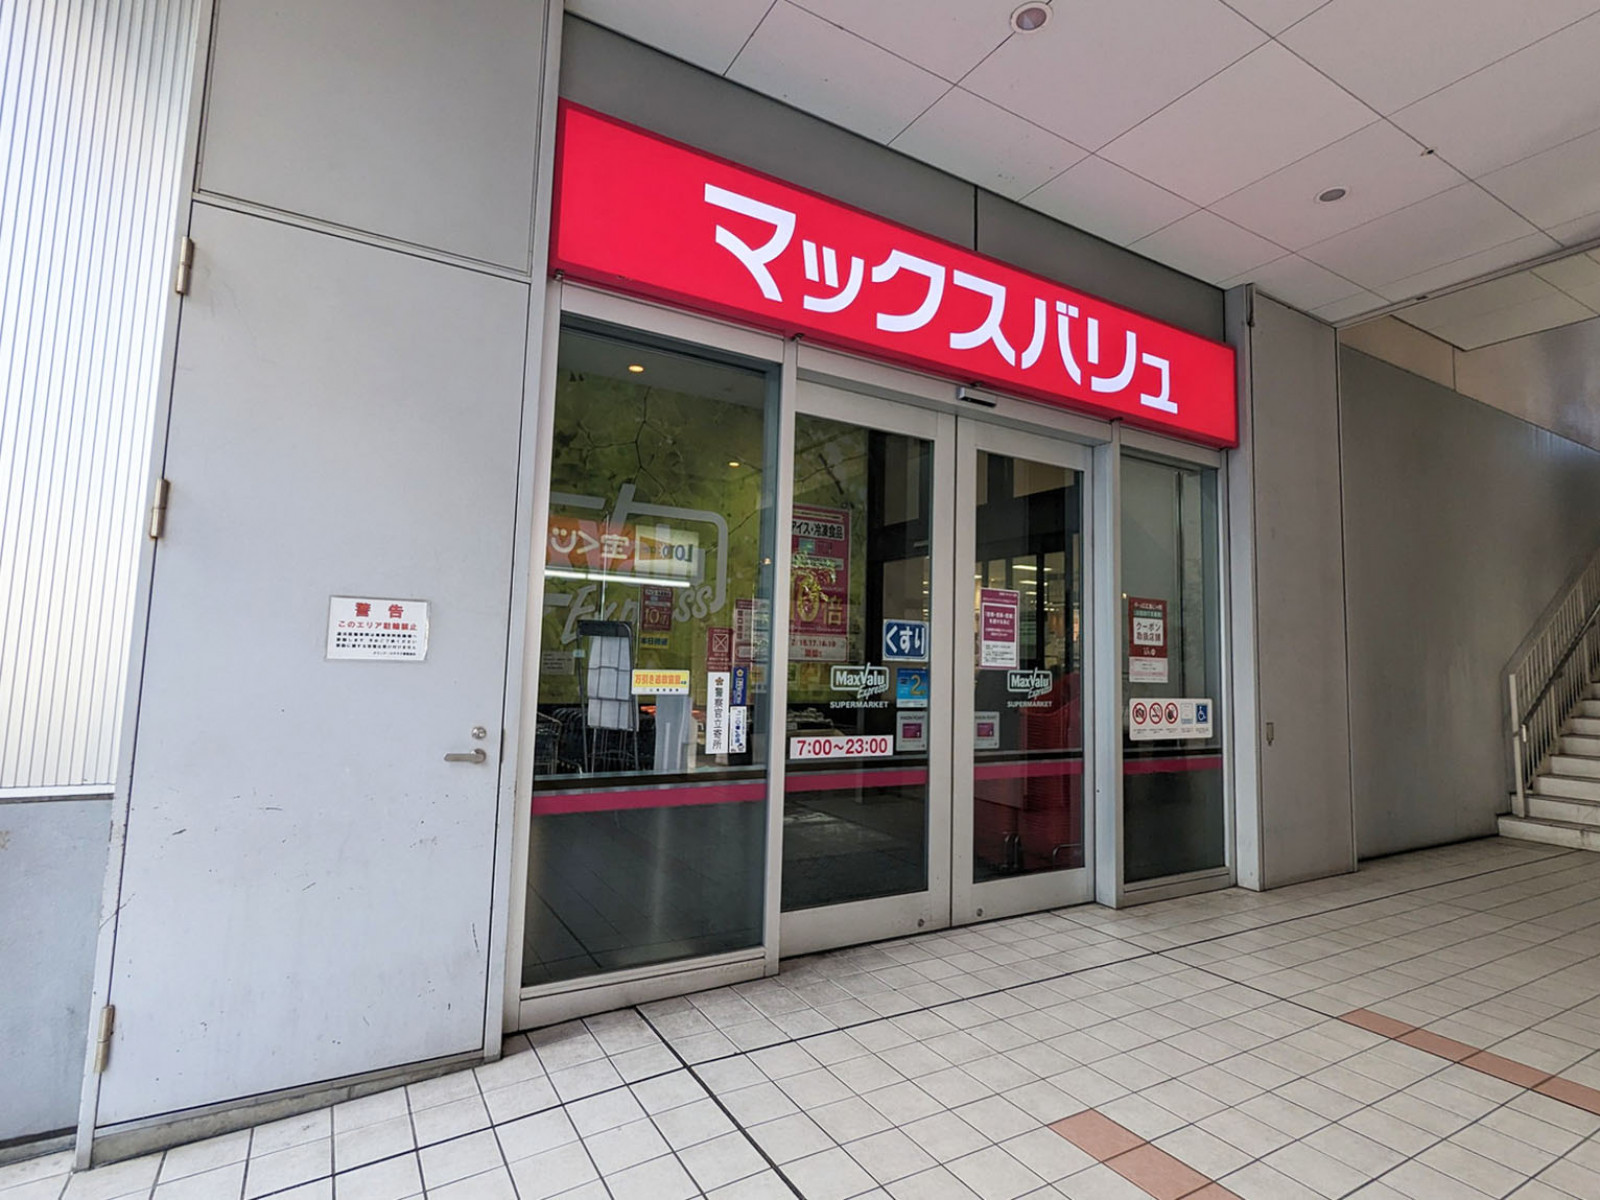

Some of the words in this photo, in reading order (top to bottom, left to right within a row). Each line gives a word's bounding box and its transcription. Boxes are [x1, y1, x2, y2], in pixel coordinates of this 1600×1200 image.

[703, 183, 1178, 414] マックスバリュ
[355, 602, 404, 619] 警告
[1136, 622, 1161, 632] クーポン
[885, 625, 925, 655] くすり
[835, 662, 885, 686] MaxValu
[1011, 667, 1050, 688] MaxValu
[857, 683, 888, 700] Express
[830, 701, 889, 709] SUPERMARKET
[712, 687, 724, 750] 警察官立寄所
